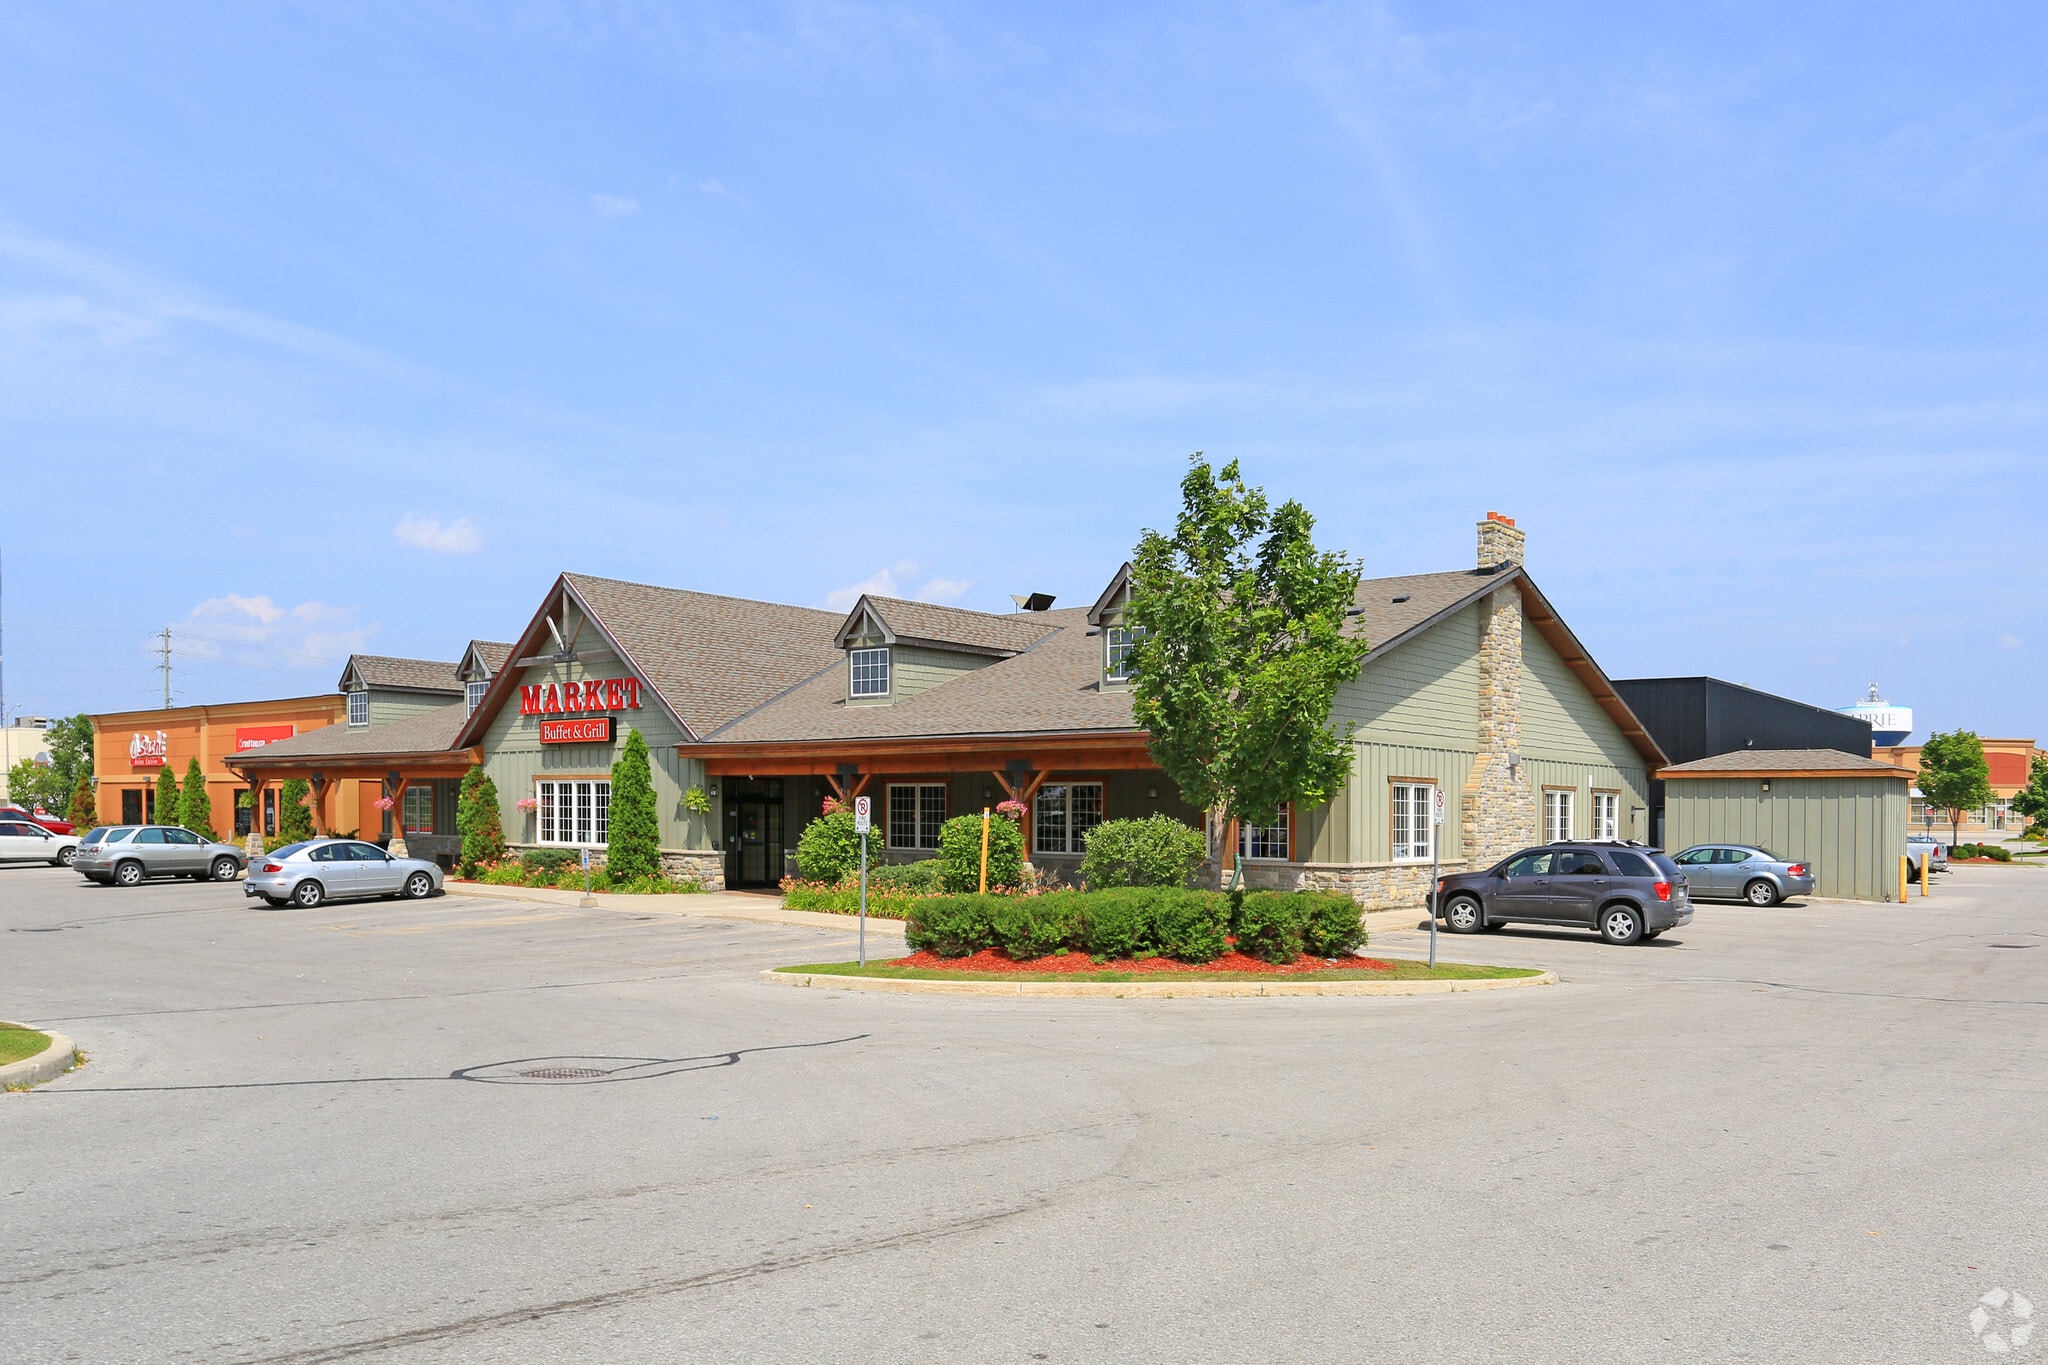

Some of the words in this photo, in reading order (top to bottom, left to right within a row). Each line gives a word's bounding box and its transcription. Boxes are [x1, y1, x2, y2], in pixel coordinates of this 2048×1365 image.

[520, 677, 643, 715] MARKET
[544, 725, 572, 740] Buffet
[573, 724, 582, 739] &
[583, 722, 605, 738] Grill
